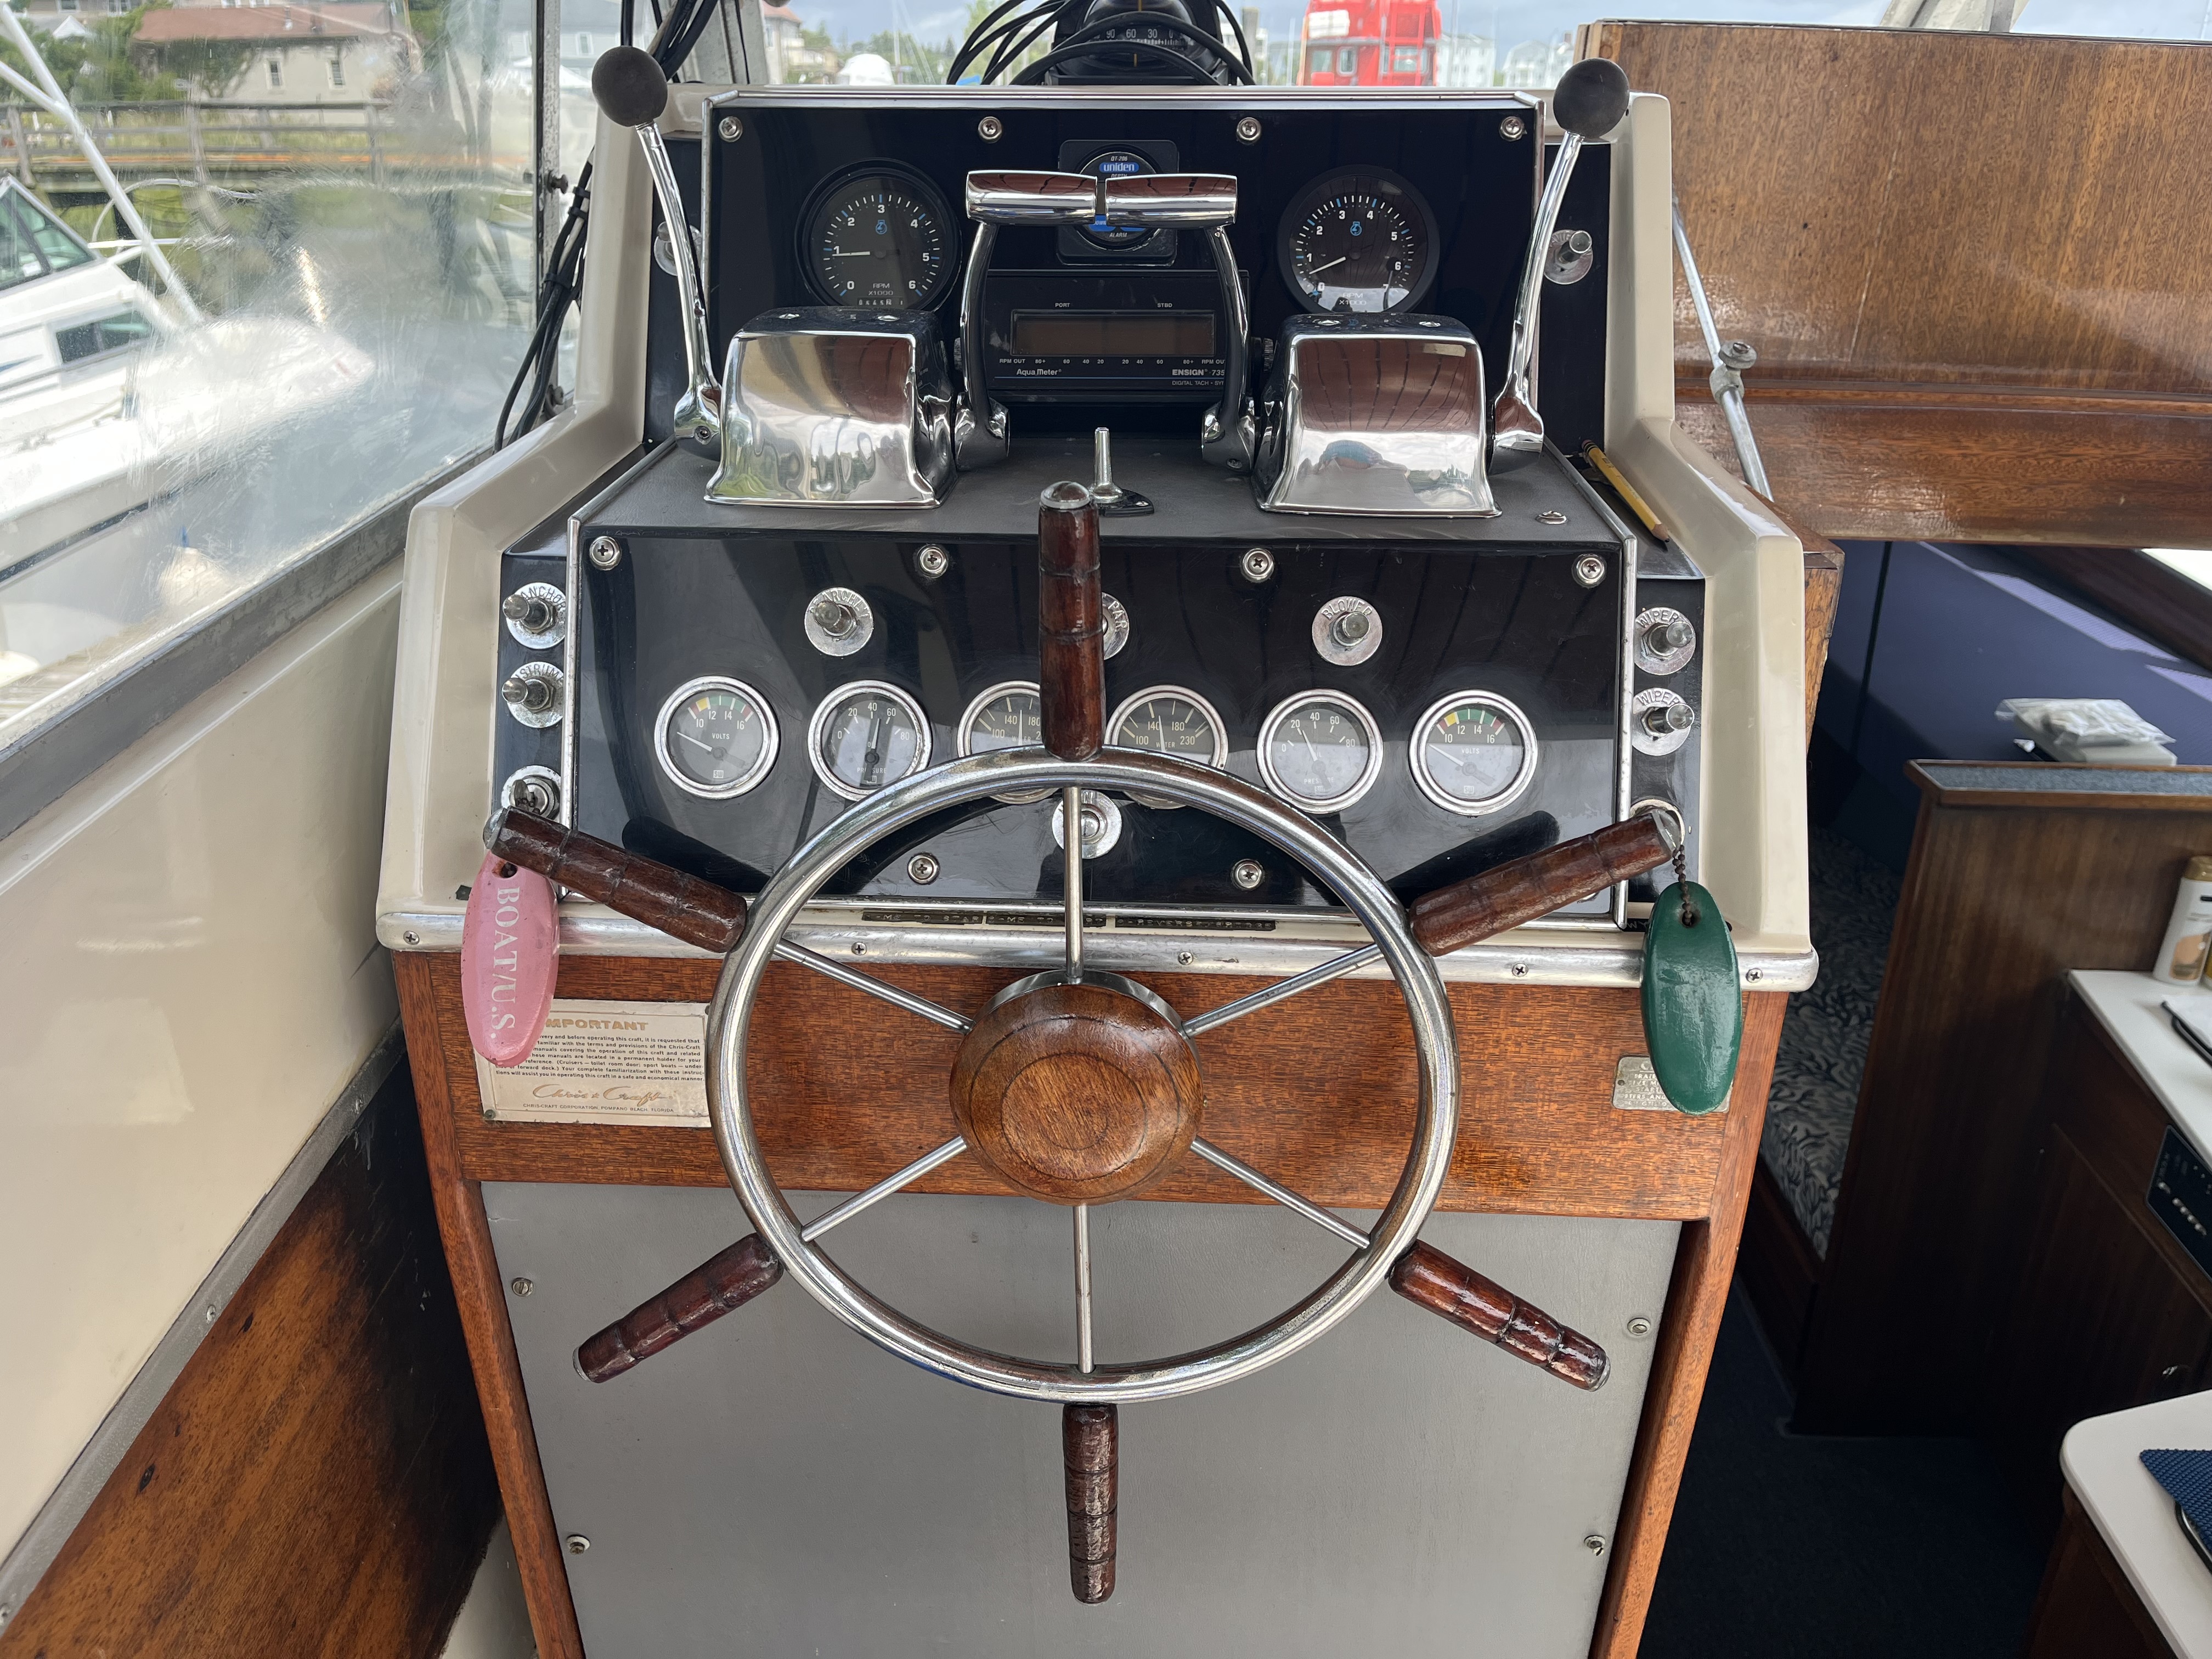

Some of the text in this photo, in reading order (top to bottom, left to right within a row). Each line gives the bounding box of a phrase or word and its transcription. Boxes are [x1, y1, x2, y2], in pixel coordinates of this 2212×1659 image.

[1106, 29, 1158, 38] 90 60 30
[1103, 163, 1135, 172] uniden
[878, 205, 885, 213] 3
[1339, 211, 1345, 219] 3
[1367, 211, 1374, 219] 4
[848, 217, 855, 226] 2
[910, 219, 918, 228] 4
[1317, 226, 1323, 235] 2
[1391, 232, 1397, 240] 5
[833, 246, 839, 254] 1
[922, 253, 929, 262] 5
[1306, 253, 1312, 262] 1
[1395, 262, 1401, 270] 6
[847, 281, 855, 290] 0
[909, 280, 916, 289] 6
[521, 586, 566, 610] ANCHOR
[1321, 598, 1373, 620] BLOWER
[1635, 608, 1680, 628] WIPER
[1636, 687, 1680, 706] WIPER
[867, 702, 877, 711] 40
[708, 711, 732, 720] 12 14
[848, 708, 857, 716] 20
[887, 708, 896, 716] 60
[1310, 712, 1319, 721] 40
[696, 719, 704, 728] 10
[1005, 715, 1041, 726] 140 180
[1291, 719, 1300, 729] 20
[1330, 716, 1340, 724] 60
[737, 720, 744, 730] 16
[1148, 721, 1184, 731] 140 180
[1458, 725, 1482, 734] 12 14
[837, 730, 842, 739] 0
[900, 732, 910, 741] 80
[992, 729, 1005, 738] 100
[1136, 736, 1149, 744] 100
[1180, 736, 1195, 745] 230
[1346, 738, 1355, 747] 80
[1445, 734, 1452, 743] 10
[1487, 735, 1495, 743] 16
[1282, 744, 1286, 752] 0
[545, 1019, 649, 1031] MPORTANT
